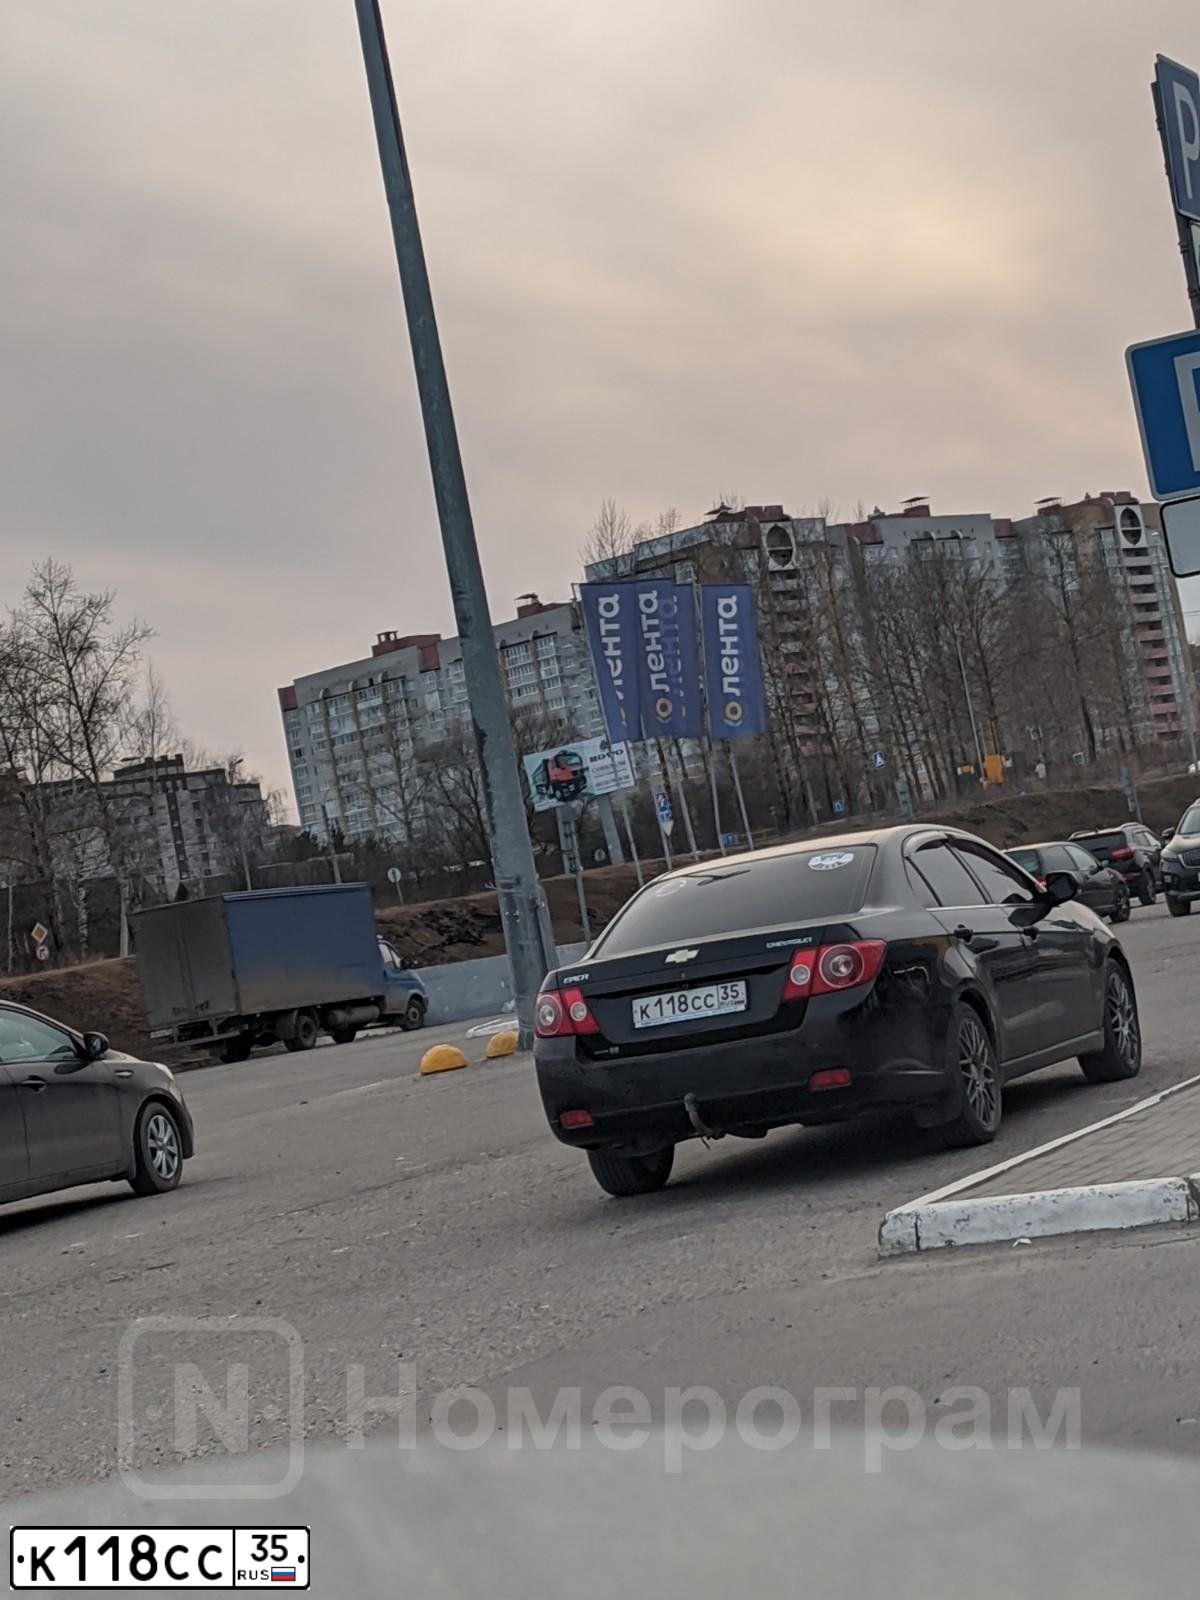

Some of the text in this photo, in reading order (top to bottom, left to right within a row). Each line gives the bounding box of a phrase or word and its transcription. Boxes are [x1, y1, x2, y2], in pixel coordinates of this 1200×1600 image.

[638, 590, 670, 693] лента
[717, 595, 740, 697] лента
[720, 983, 740, 1001] 35
